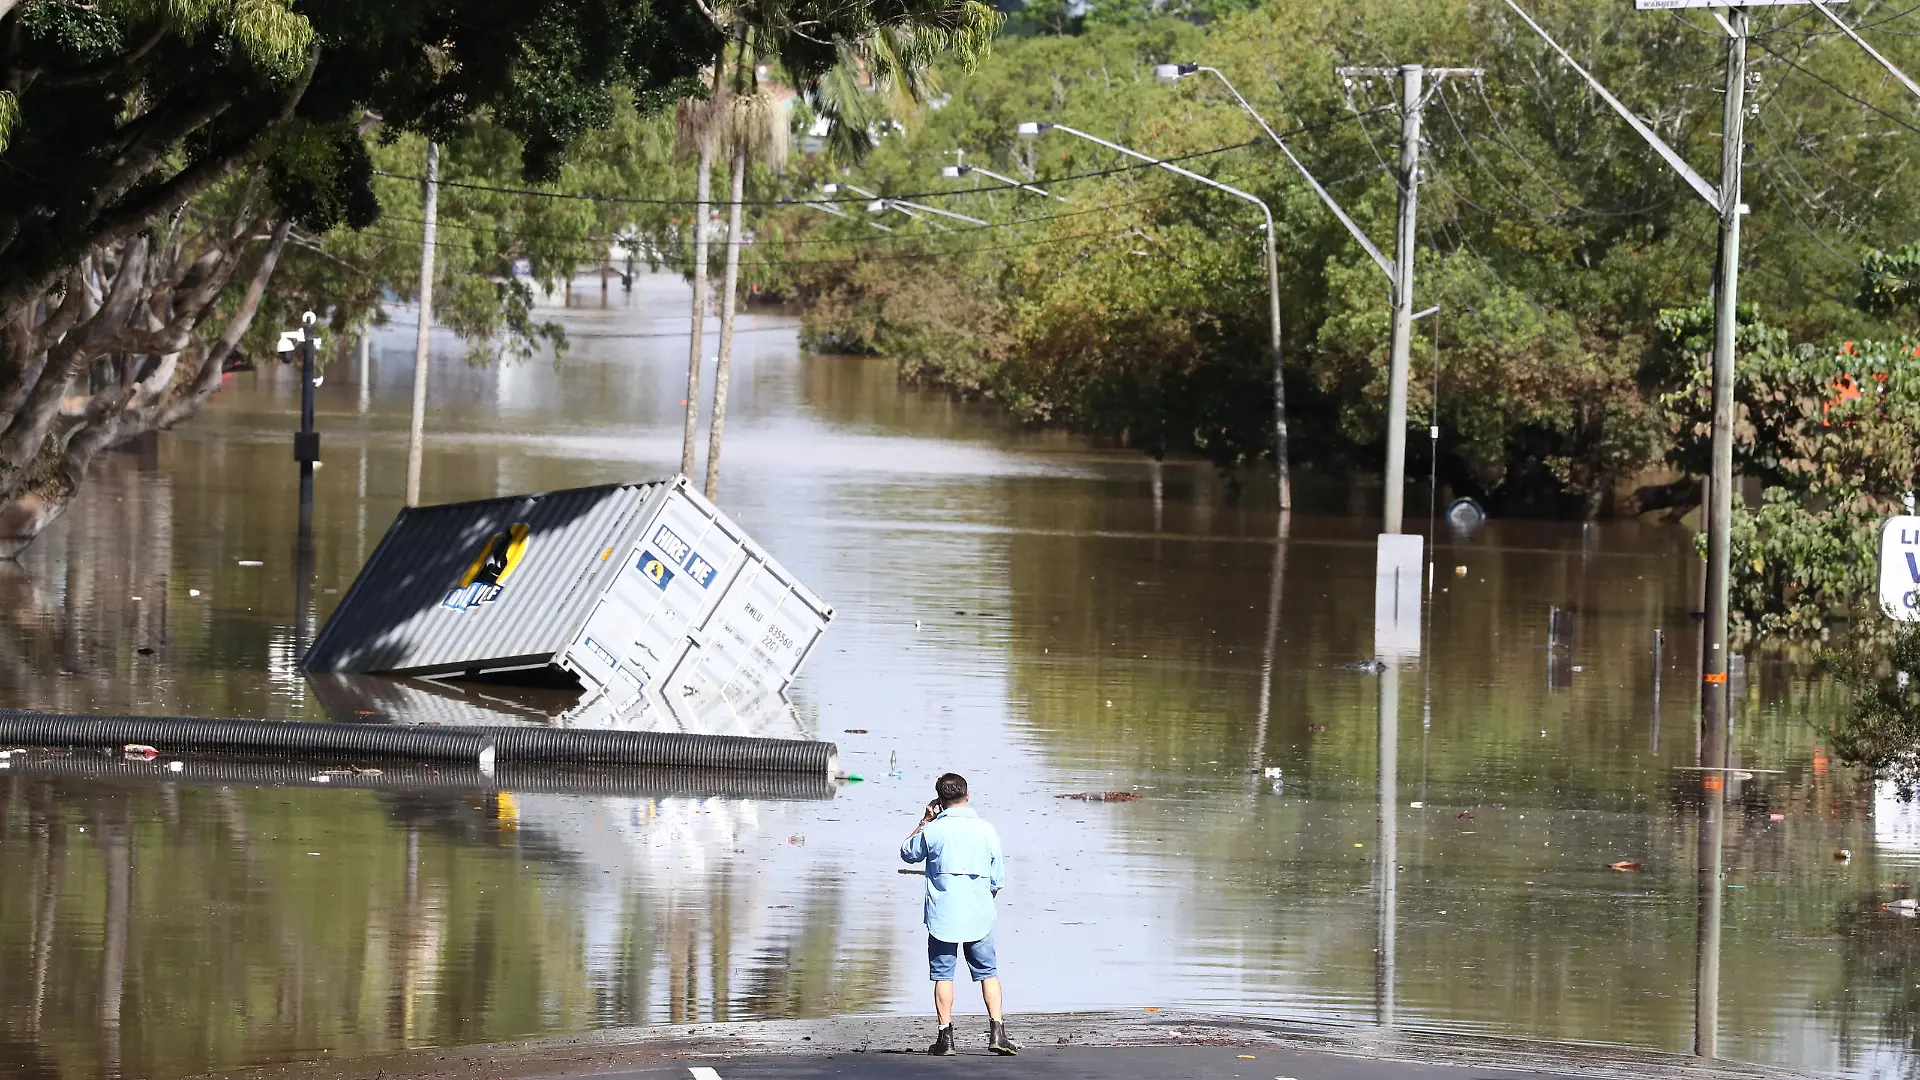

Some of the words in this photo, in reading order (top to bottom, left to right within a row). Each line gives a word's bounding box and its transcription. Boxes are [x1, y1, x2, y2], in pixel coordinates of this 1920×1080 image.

[654, 526, 689, 564] HIRE
[688, 556, 713, 584] ME
[744, 603, 763, 622] RWLU
[768, 624, 793, 649] 835560
[762, 635, 779, 653] 22G1
